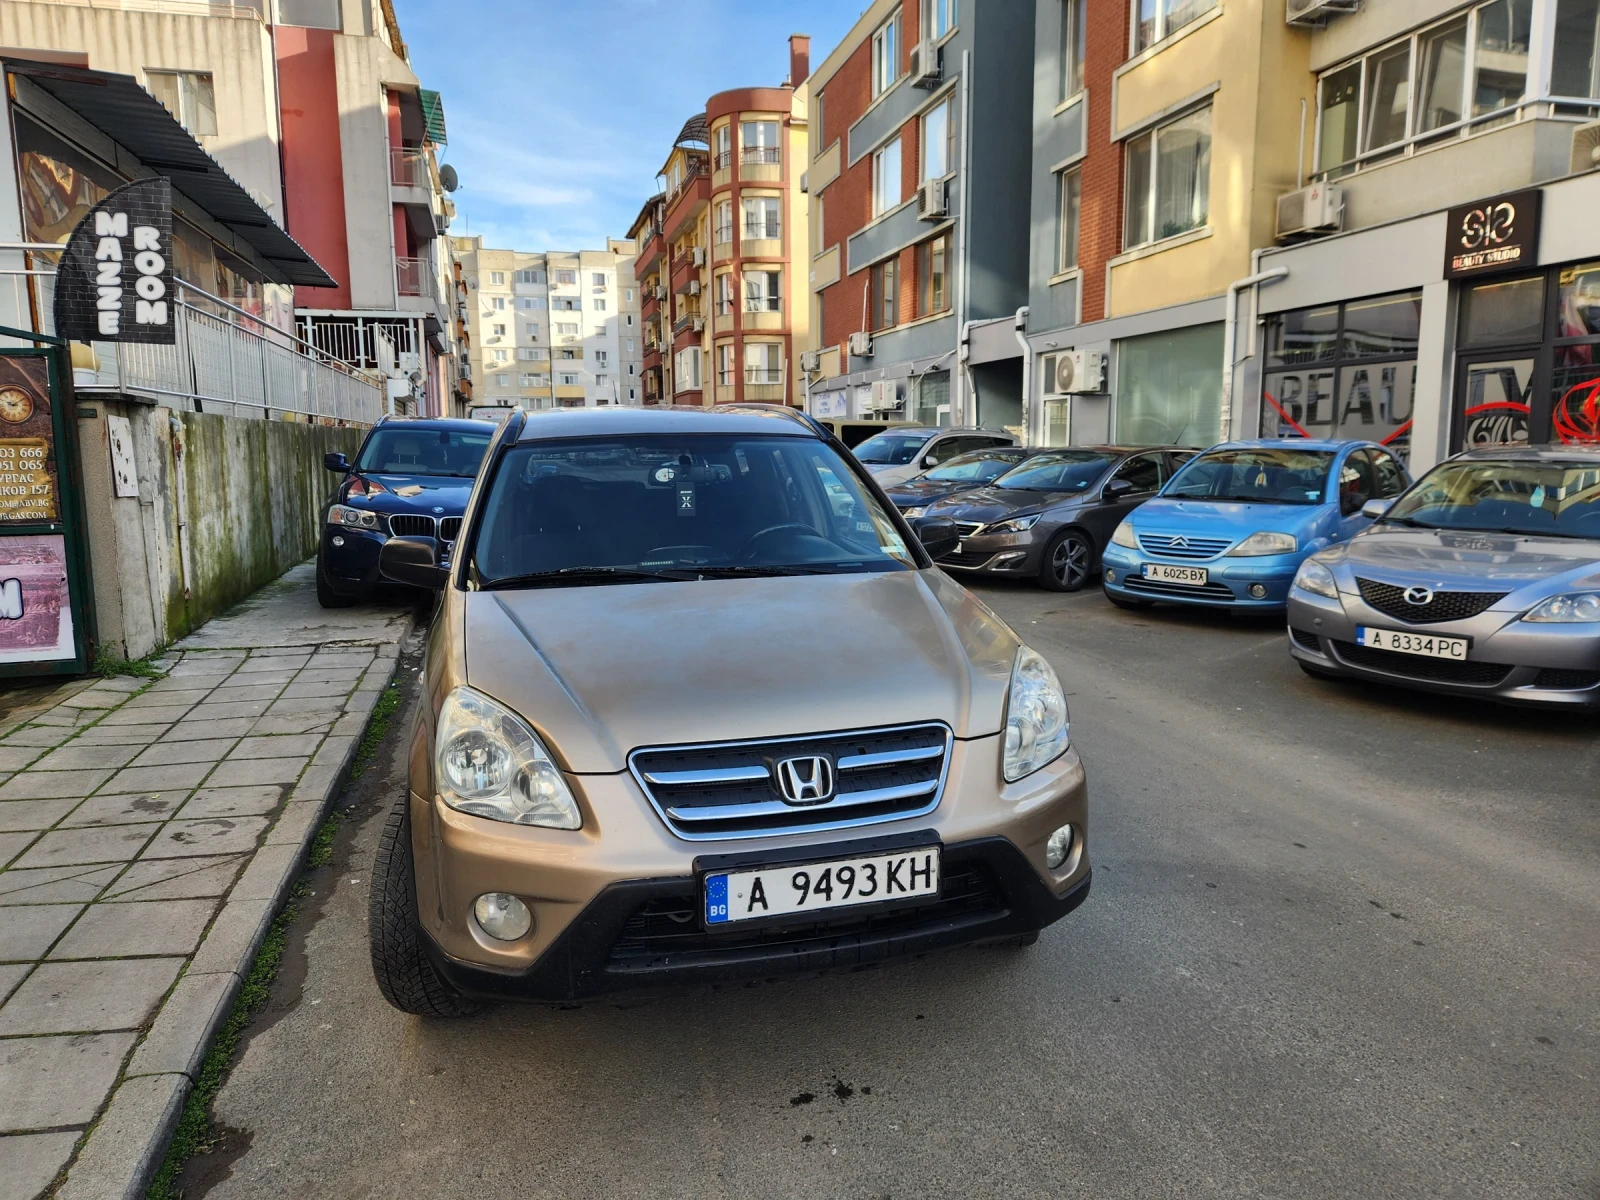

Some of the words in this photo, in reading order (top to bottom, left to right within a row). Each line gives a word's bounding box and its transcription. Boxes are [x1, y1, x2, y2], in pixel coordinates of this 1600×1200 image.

[1452, 254, 1485, 269] BEAUTY
[1486, 247, 1521, 263] STUDIO
[95, 211, 128, 335] MAZZE
[133, 226, 168, 325] ROOM
[20, 448, 43, 458] 666
[0, 461, 14, 470] 51
[0, 486, 26, 495] КОВ
[31, 485, 49, 495] 157
[1152, 566, 1158, 577] A
[1372, 631, 1382, 646] A
[747, 877, 768, 912] A
[710, 905, 726, 917] BG
